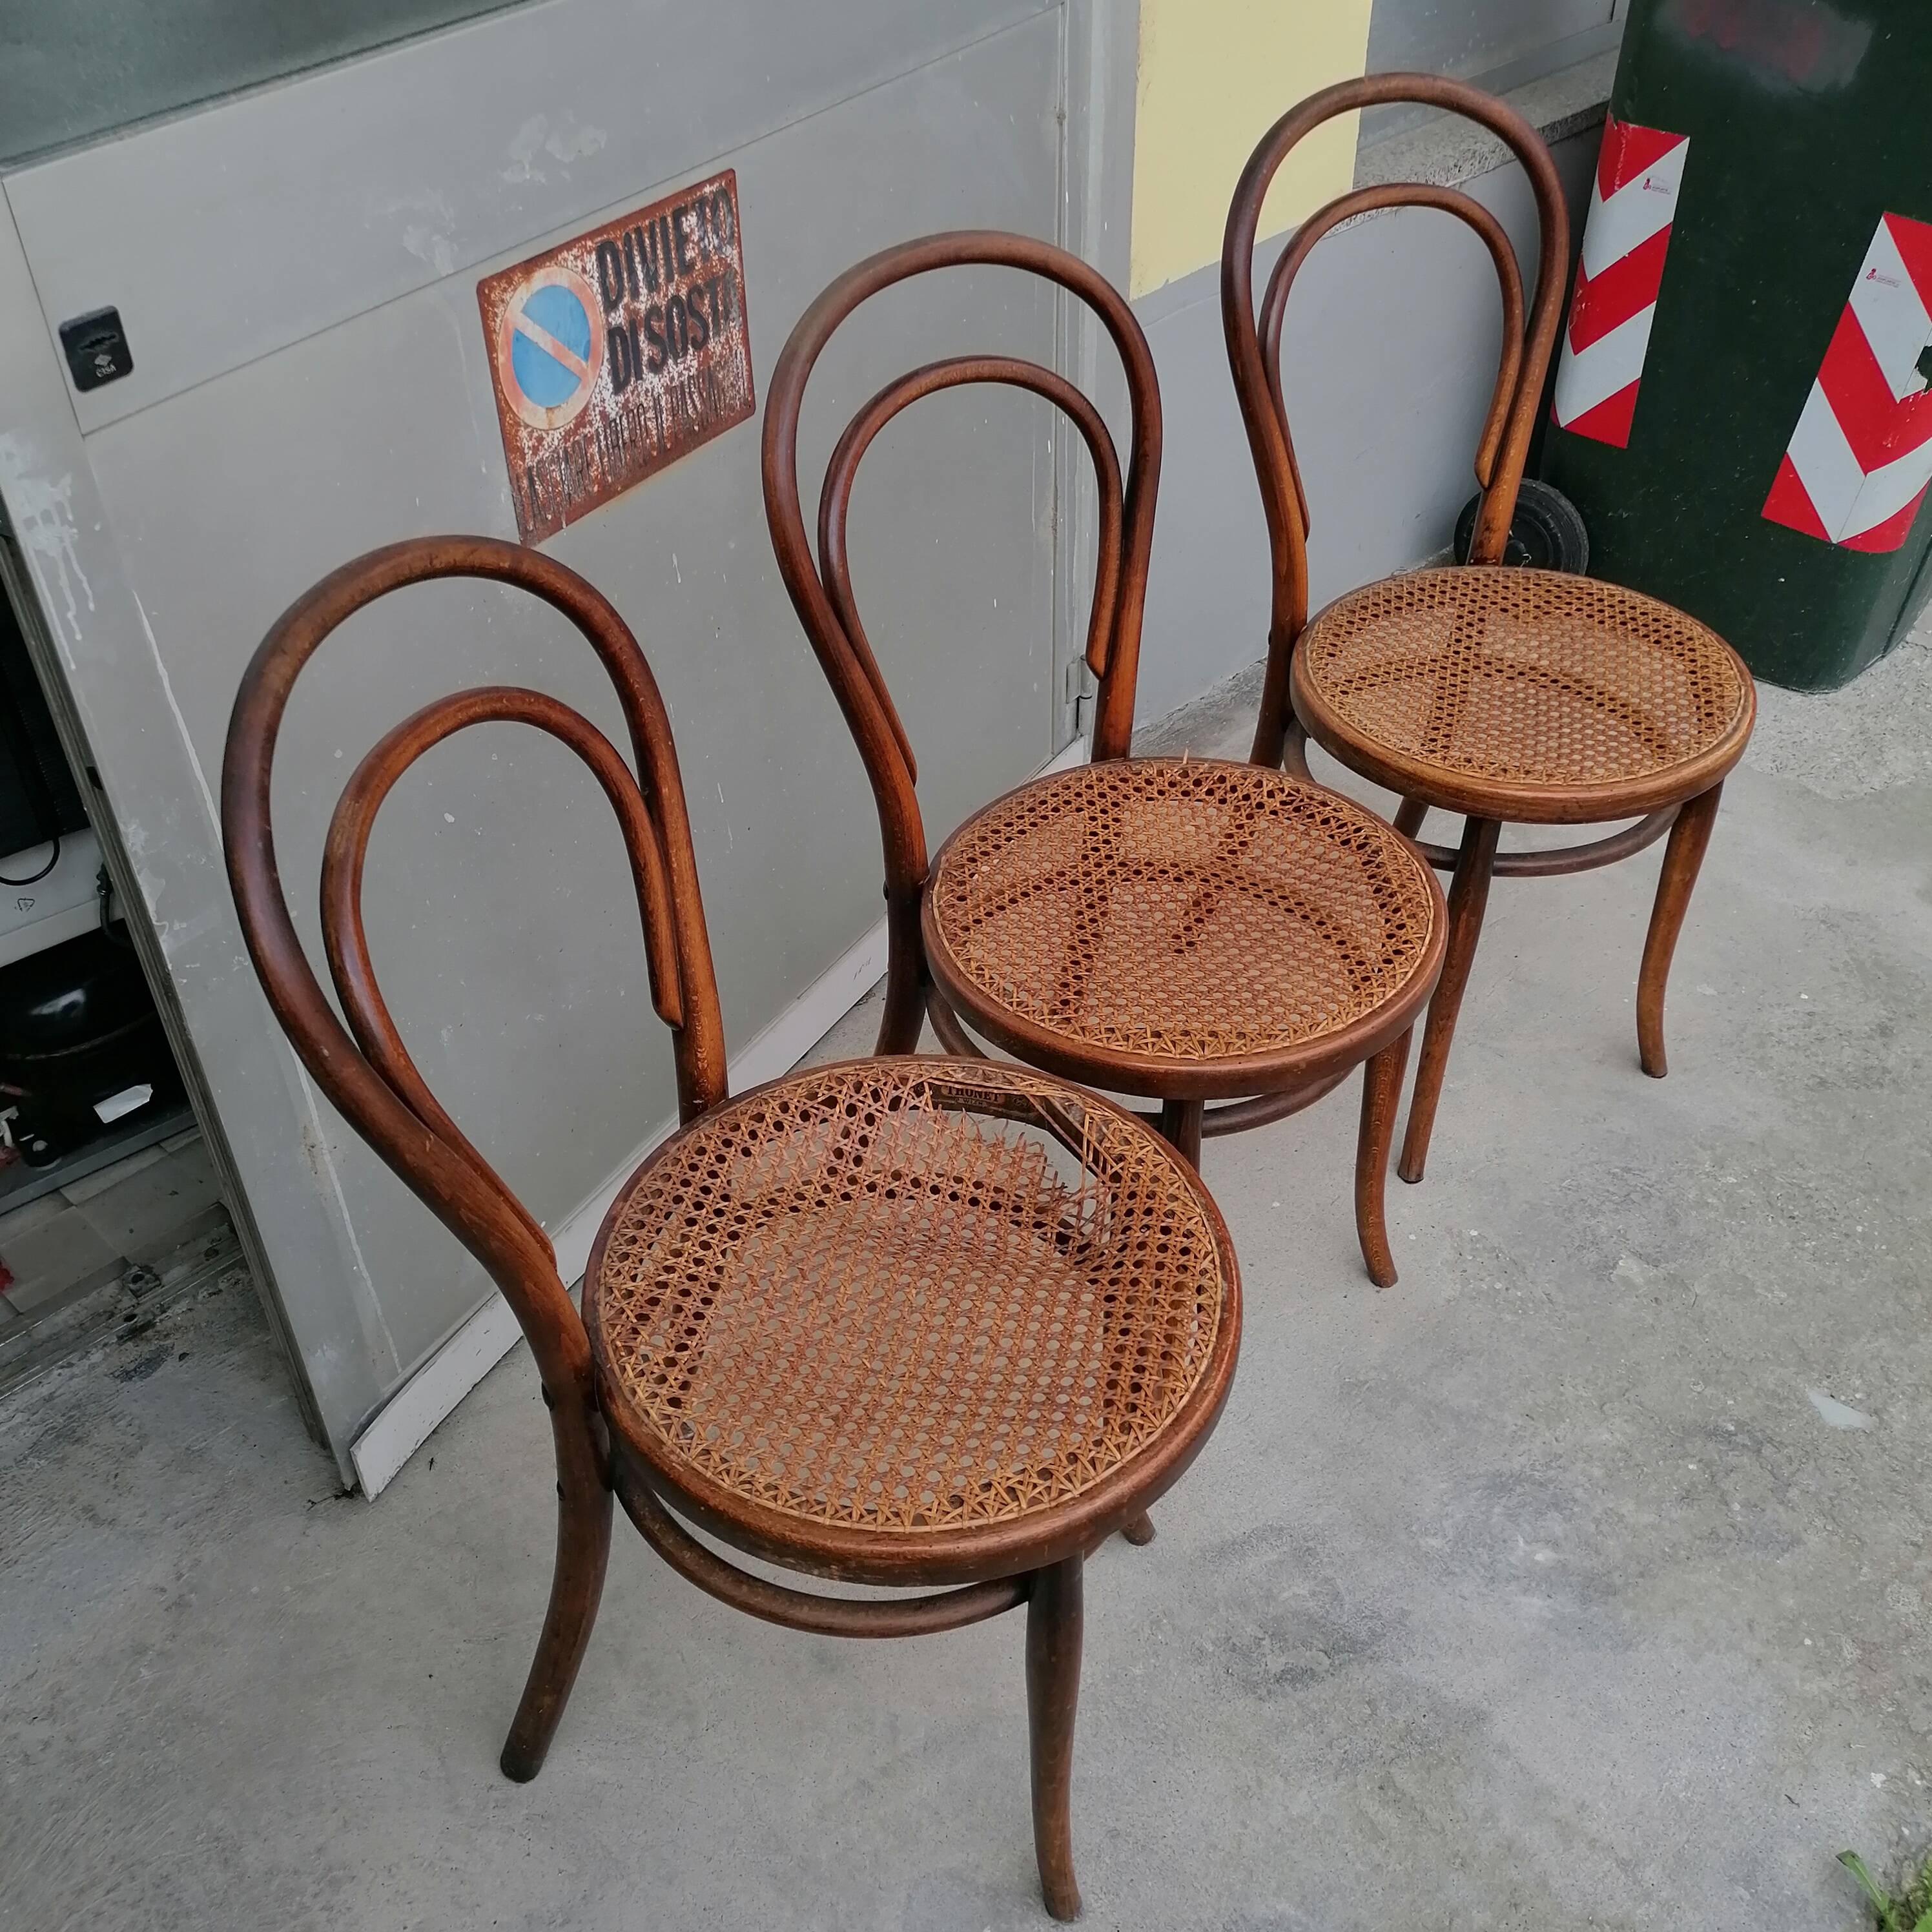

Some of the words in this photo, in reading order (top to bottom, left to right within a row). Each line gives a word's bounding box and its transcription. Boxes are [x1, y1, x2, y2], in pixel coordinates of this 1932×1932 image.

[597, 187, 735, 312] DIVIETO
[608, 320, 642, 395] DI
[644, 268, 741, 373] SOSTA
[947, 1086, 1002, 1102] THONET
